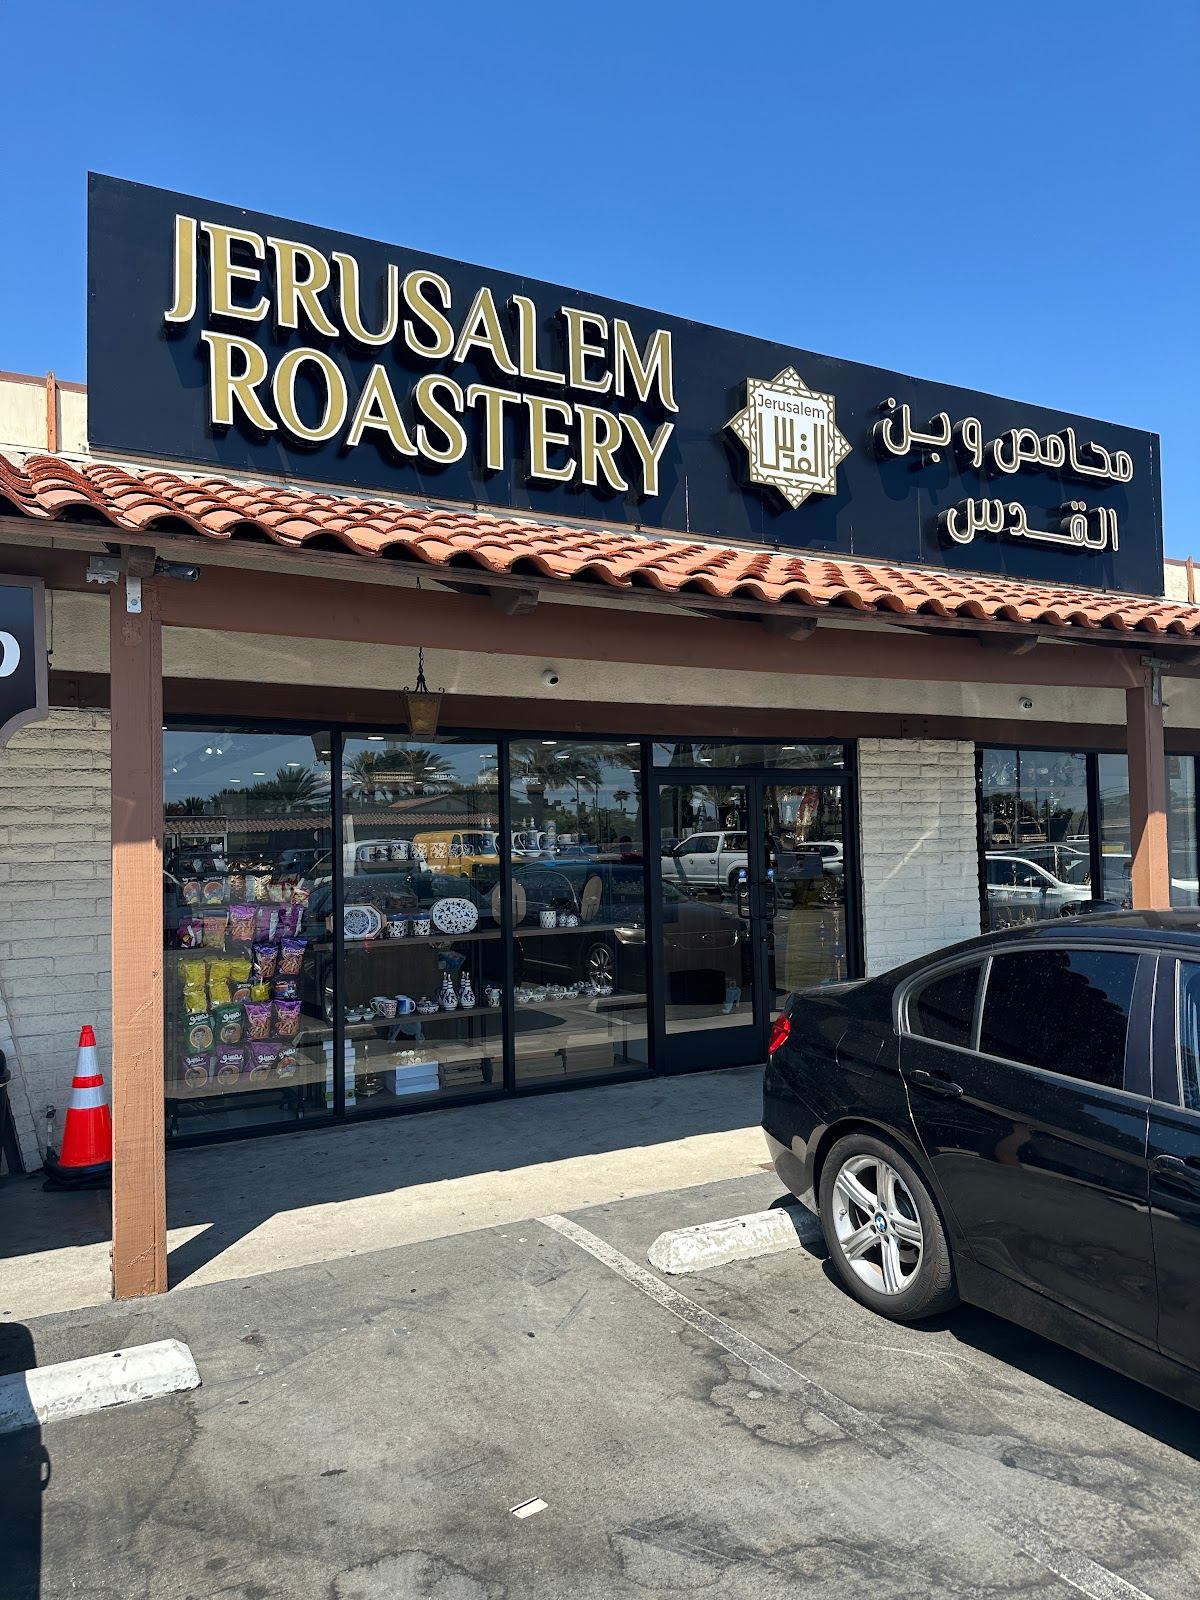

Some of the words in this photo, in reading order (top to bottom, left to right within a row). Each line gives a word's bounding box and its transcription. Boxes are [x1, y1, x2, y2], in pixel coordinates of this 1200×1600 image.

[165, 213, 679, 413] JERUSALEM
[201, 330, 675, 497] ROASTERY
[757, 393, 825, 419] Jerusalem
[758, 412, 826, 479] القدس
[993, 426, 1134, 483] محامص
[947, 497, 1119, 552] القدس
